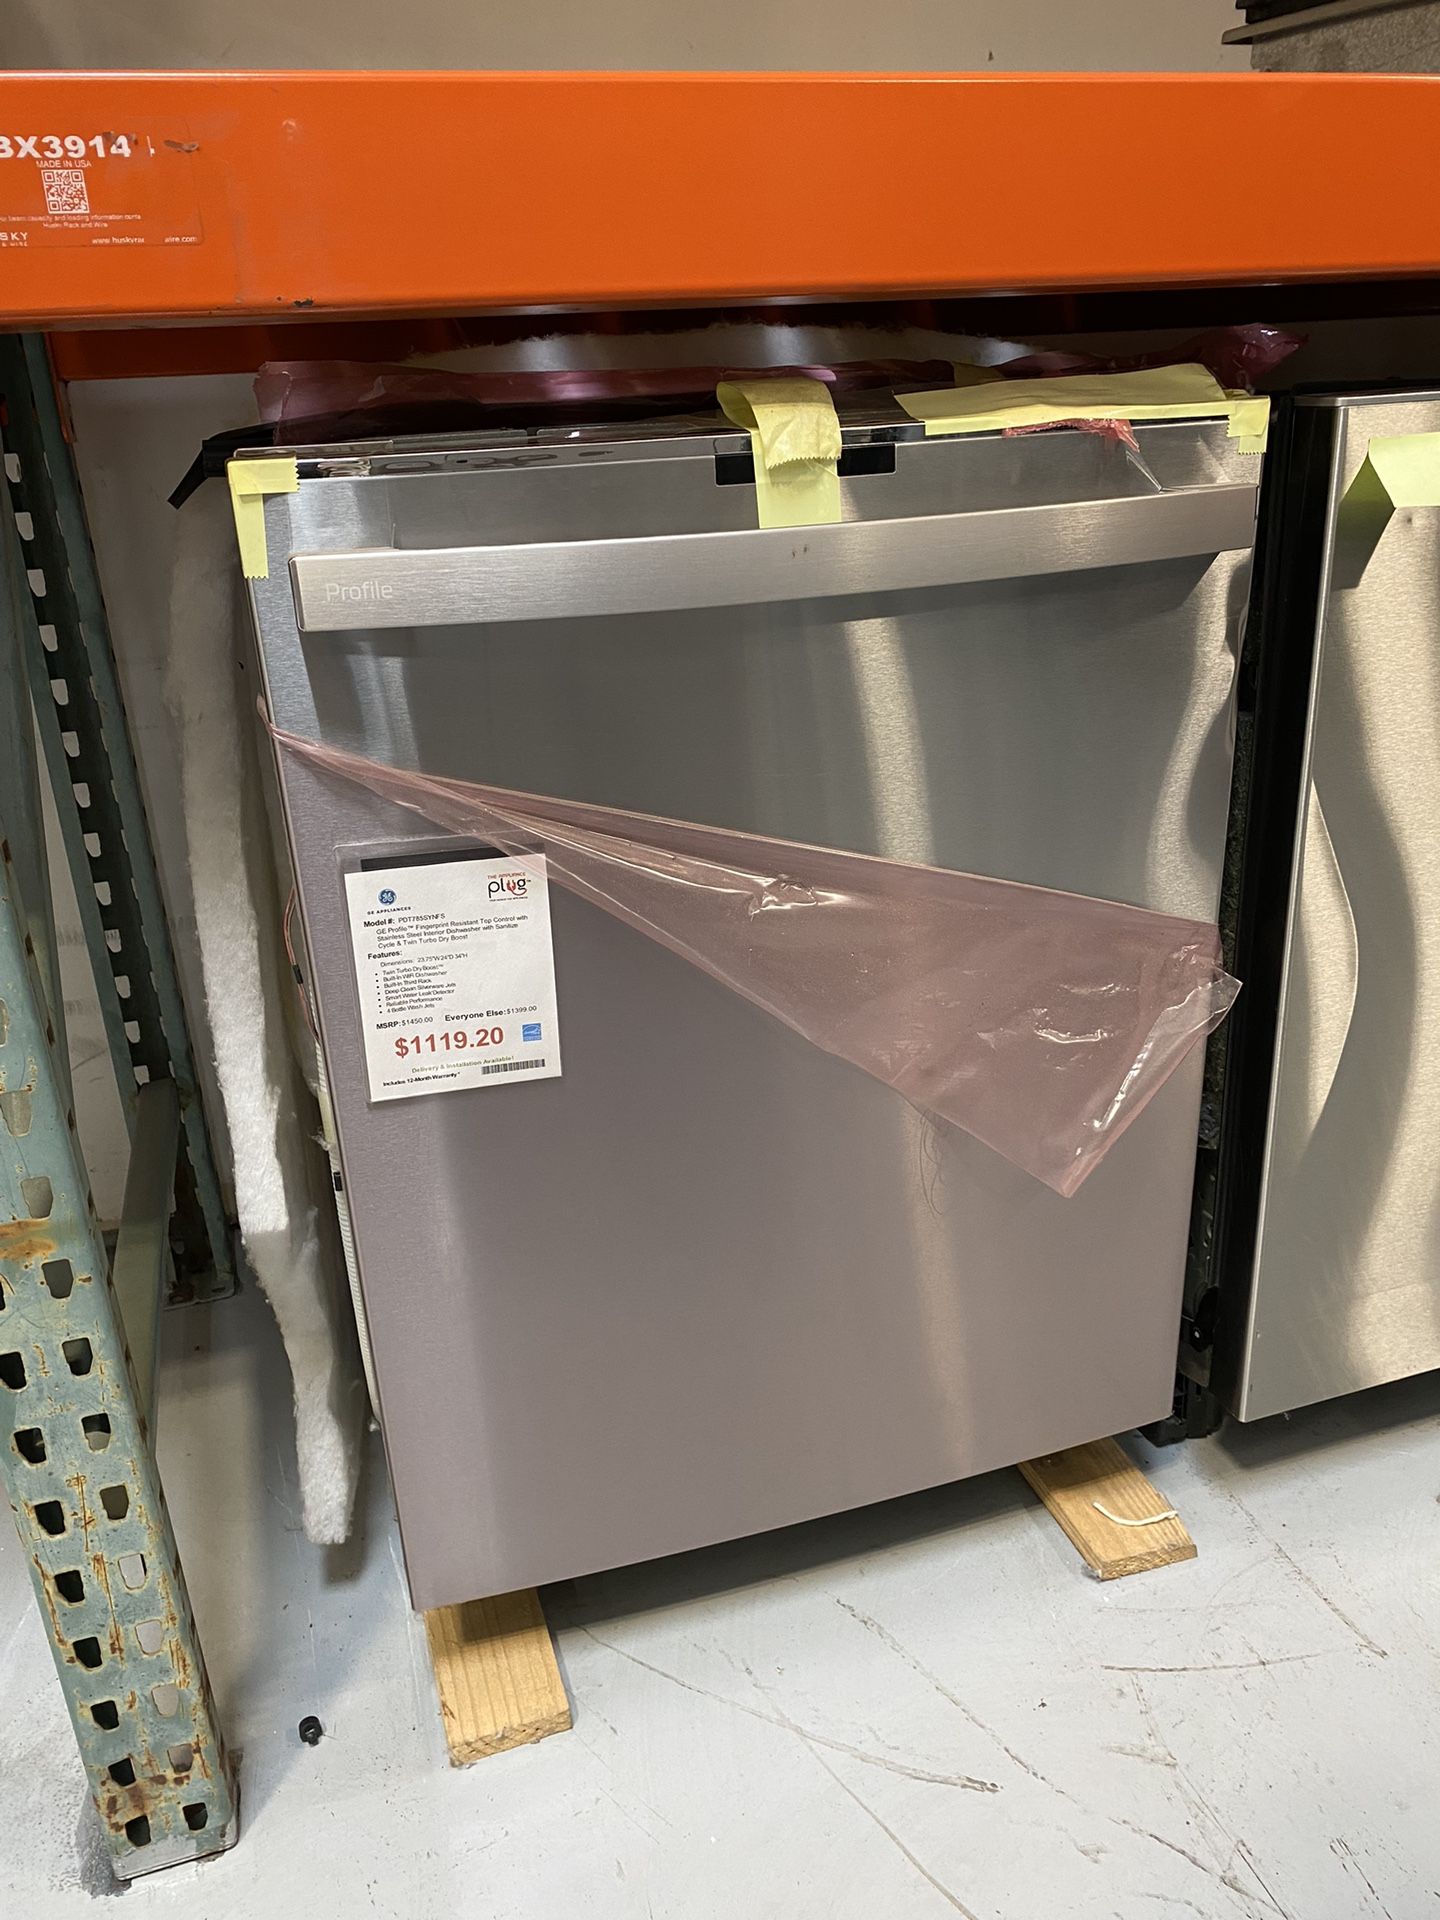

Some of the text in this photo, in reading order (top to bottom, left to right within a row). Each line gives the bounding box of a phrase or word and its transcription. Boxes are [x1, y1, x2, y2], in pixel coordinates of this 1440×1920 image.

[36, 160, 92, 168] MADE IN USA
[66, 214, 90, 222] loading
[325, 581, 394, 602] Profile
[376, 906, 412, 914] APPLIANCES
[363, 918, 386, 928] Model
[416, 922, 450, 930] Fingerprint
[450, 918, 478, 927] Resistant
[377, 934, 406, 942] Stainless
[446, 926, 481, 934] Dishwasher
[495, 922, 519, 930] Sanitize
[378, 942, 396, 950] Cycle
[403, 938, 418, 946] Twin
[419, 936, 438, 944] Turbo
[367, 950, 403, 960] Features:
[382, 968, 396, 976] Twin
[396, 966, 412, 974] Turbo
[385, 994, 402, 1002] Smart
[445, 1010, 484, 1022] Everyone
[394, 1026, 504, 1059] $1119.20
[411, 1064, 440, 1074] Delivery
[446, 1059, 482, 1070] Installation
[482, 1055, 515, 1065] Available!
[382, 1078, 406, 1087] Includes
[406, 1074, 432, 1084] 12-Month
